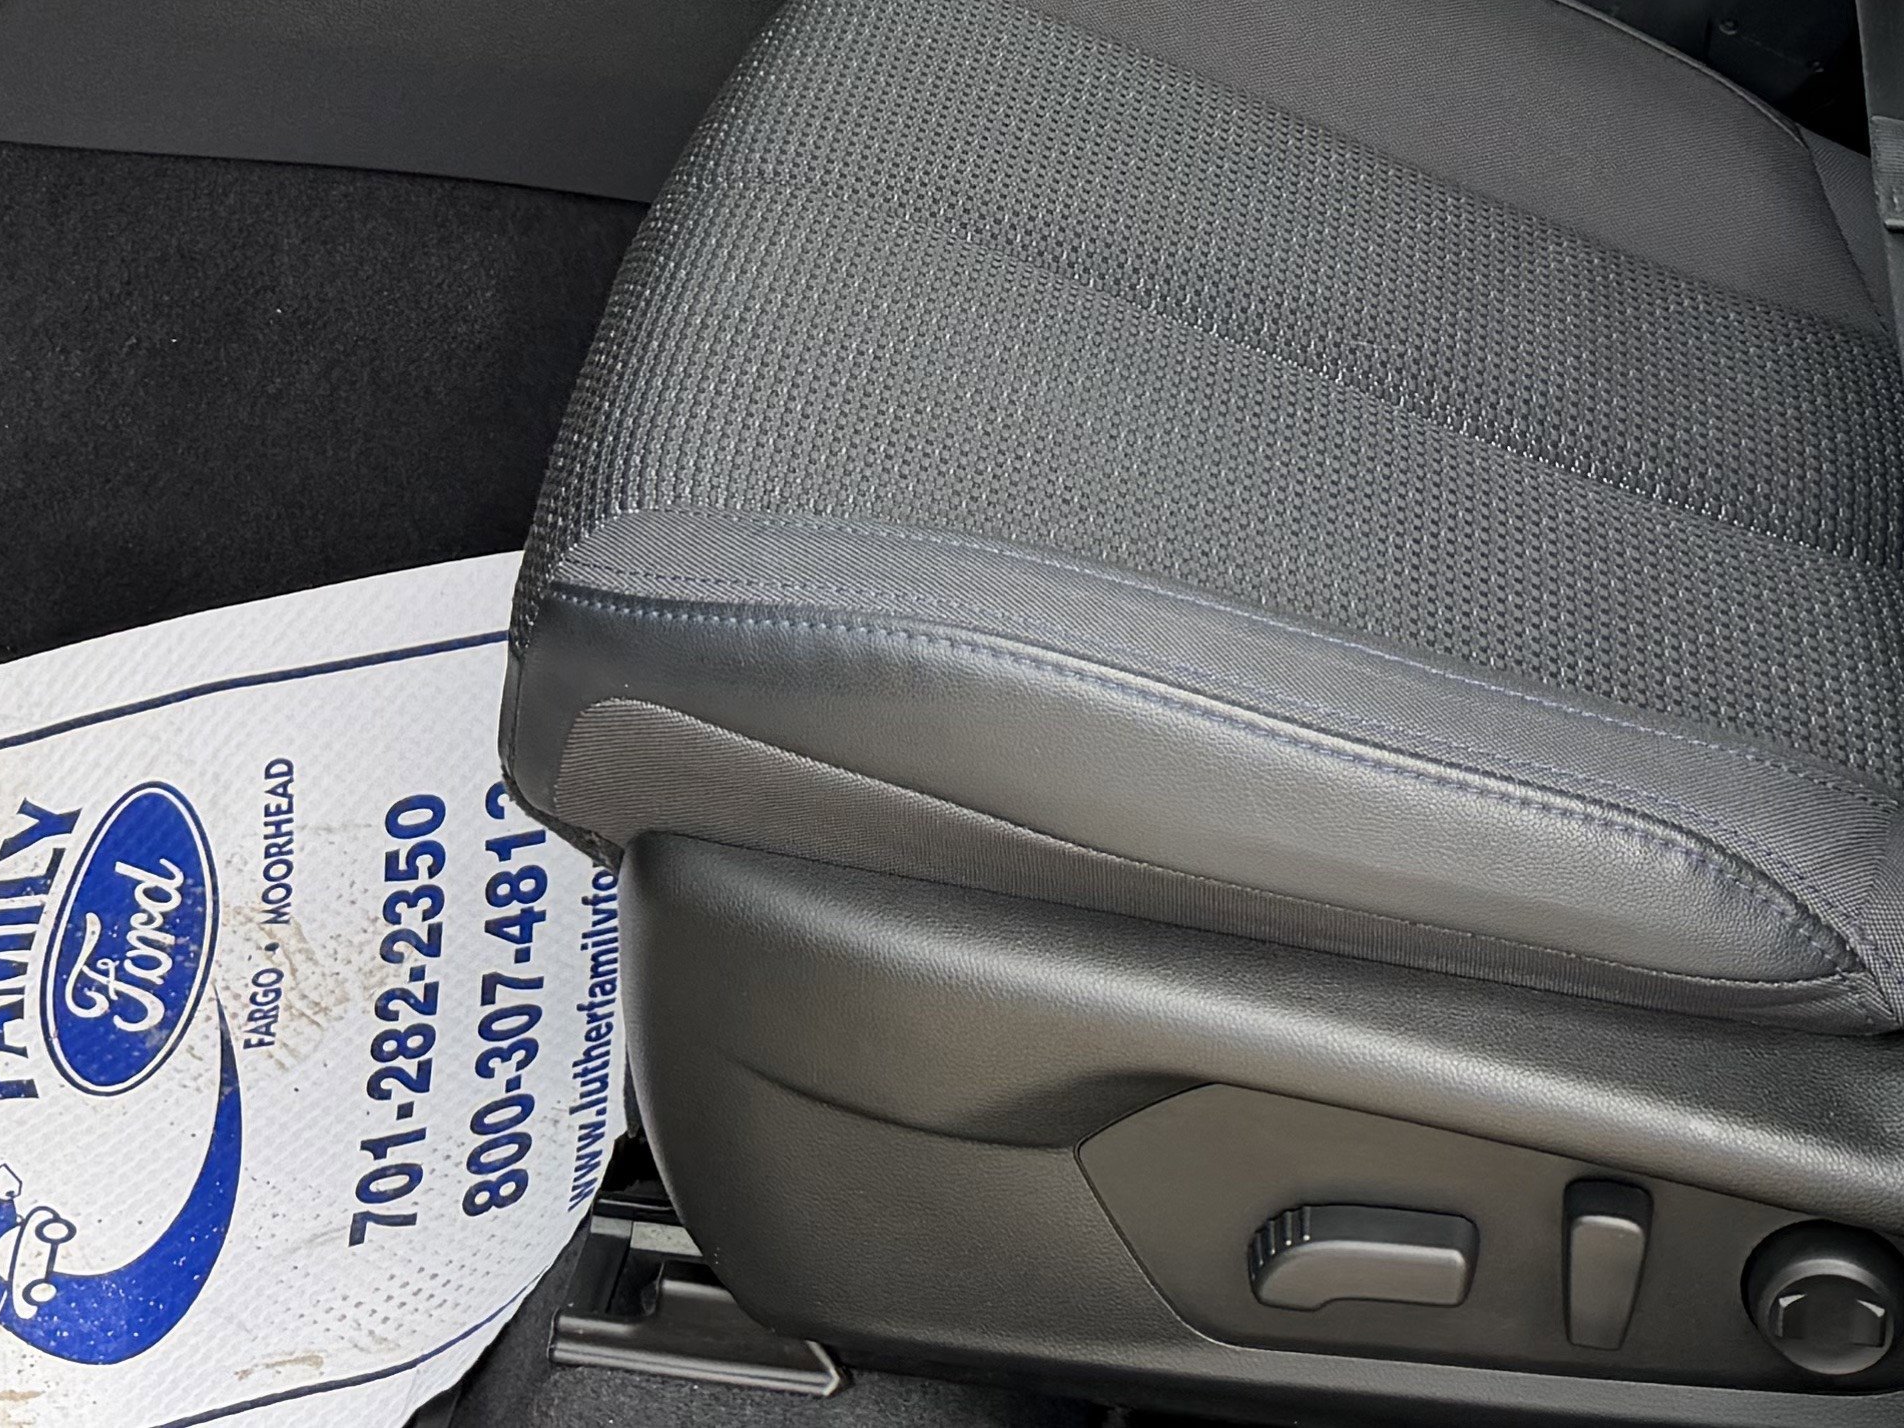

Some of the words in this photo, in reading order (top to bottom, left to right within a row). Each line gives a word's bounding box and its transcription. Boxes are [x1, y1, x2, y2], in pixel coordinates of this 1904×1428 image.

[259, 757, 296, 926] MOORHEAD
[65, 857, 185, 1033] Ford
[243, 966, 285, 1052] FARGO
[348, 792, 447, 1248] 701-282-2350
